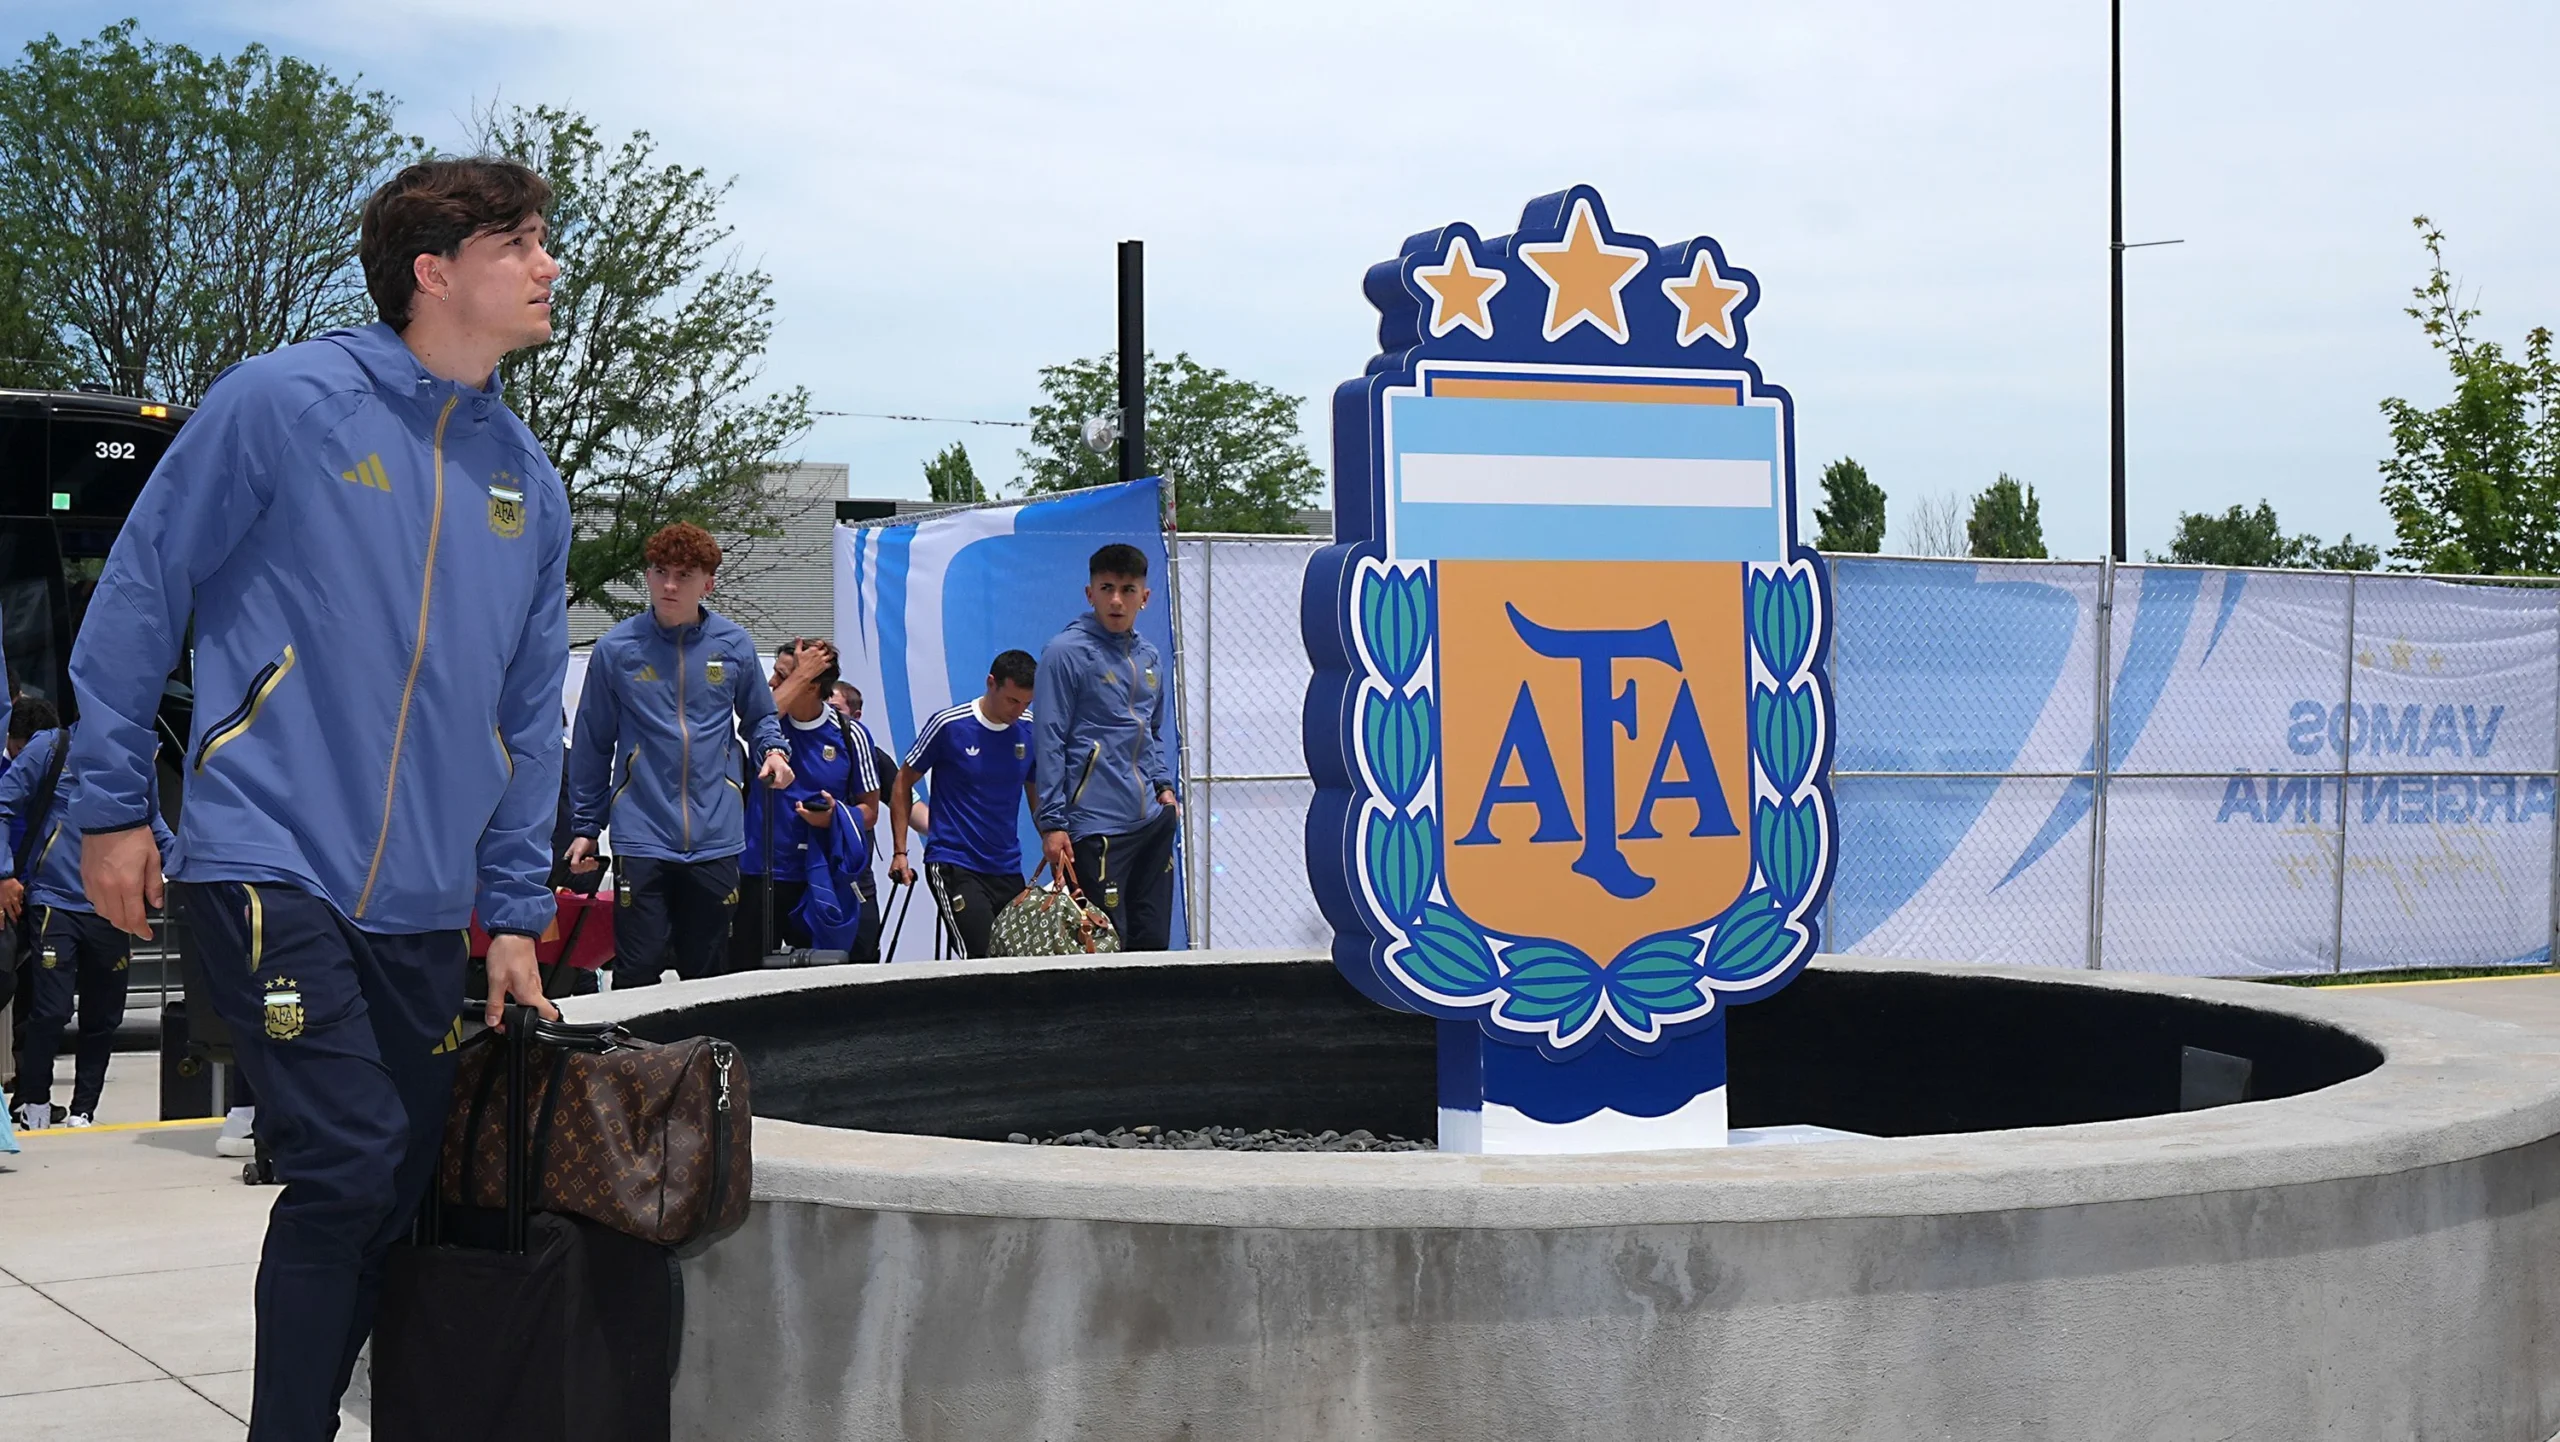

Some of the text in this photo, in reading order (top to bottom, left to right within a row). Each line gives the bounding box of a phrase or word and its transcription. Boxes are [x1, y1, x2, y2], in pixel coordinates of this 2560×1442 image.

[95, 441, 135, 459] 392
[493, 498, 517, 524] AFA
[1454, 601, 1741, 899] AFA
[270, 1003, 294, 1026] AFA
